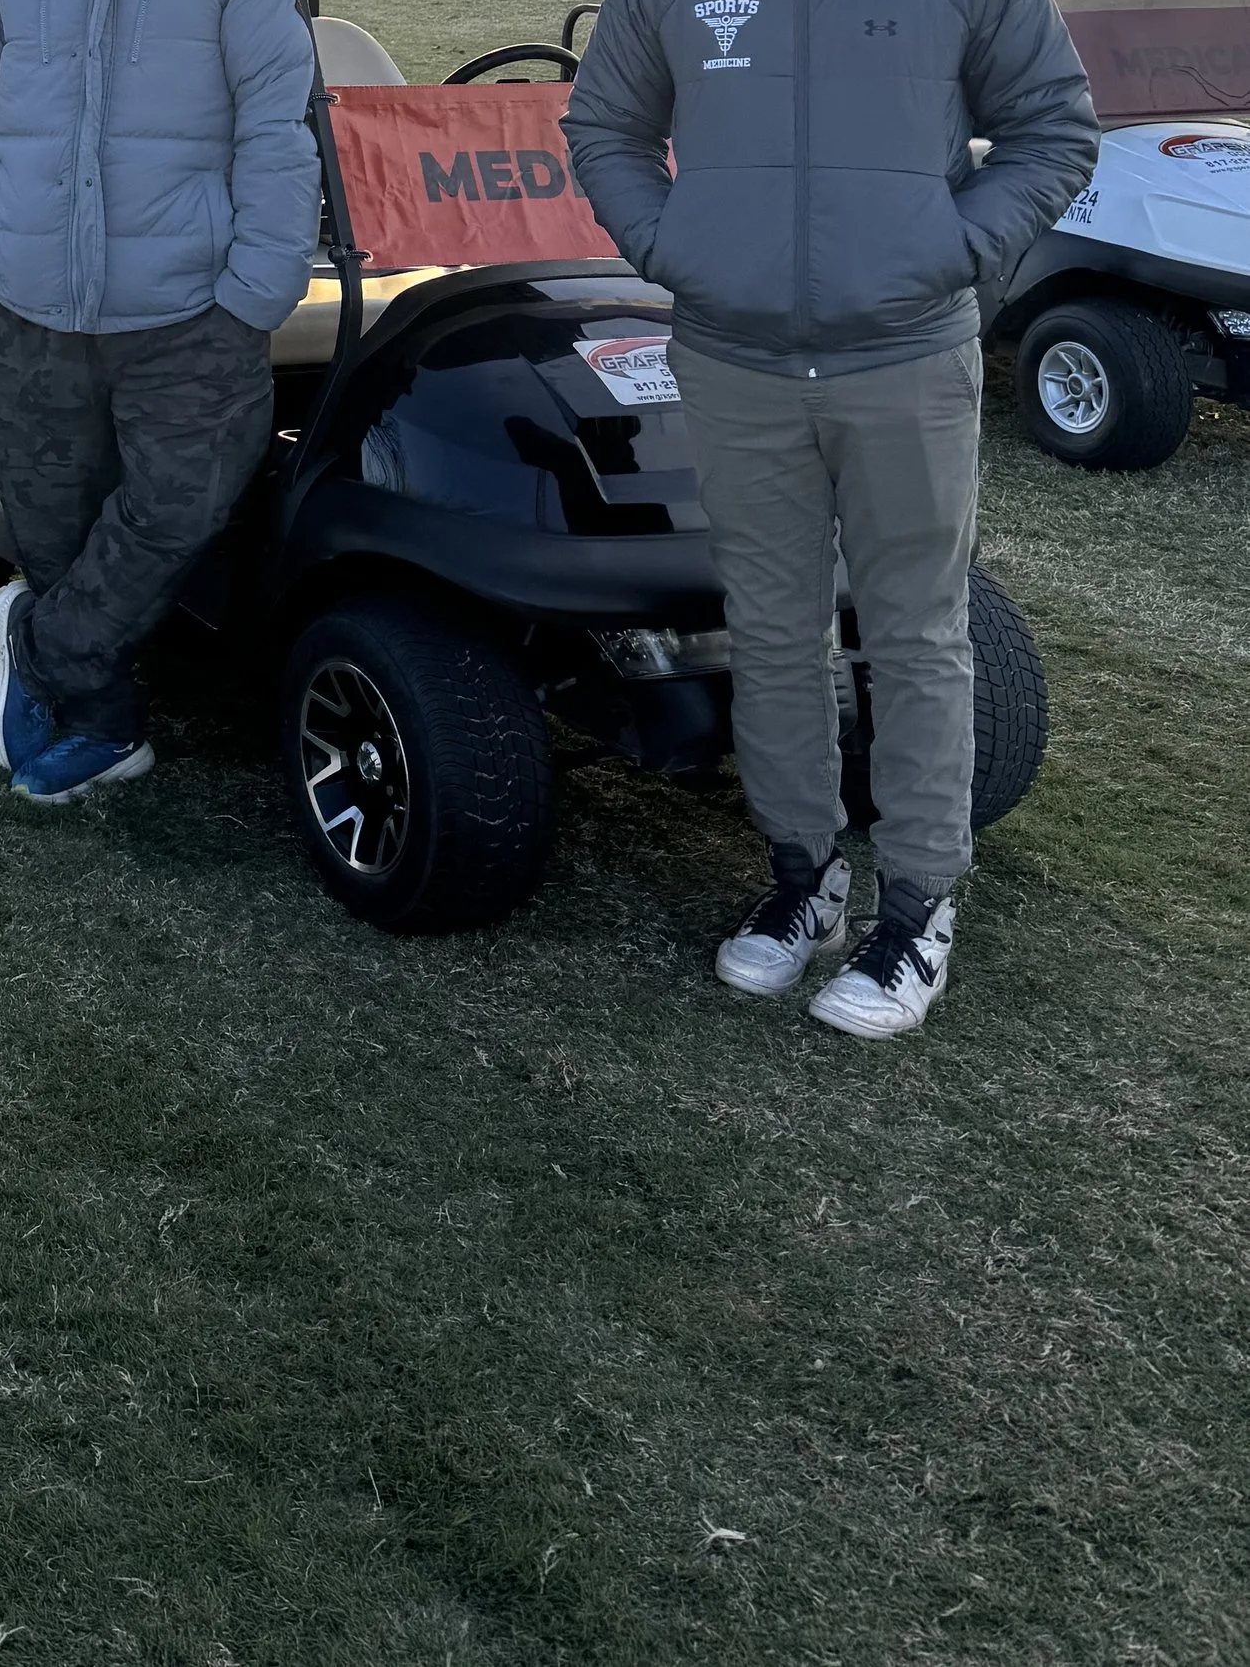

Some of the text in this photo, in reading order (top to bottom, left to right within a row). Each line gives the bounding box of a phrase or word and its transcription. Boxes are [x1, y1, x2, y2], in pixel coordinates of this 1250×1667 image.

[694, 0, 759, 18] SPORTS
[702, 57, 751, 70] MEDICINE
[1073, 189, 1099, 207] 24
[1062, 205, 1093, 224] NTAL
